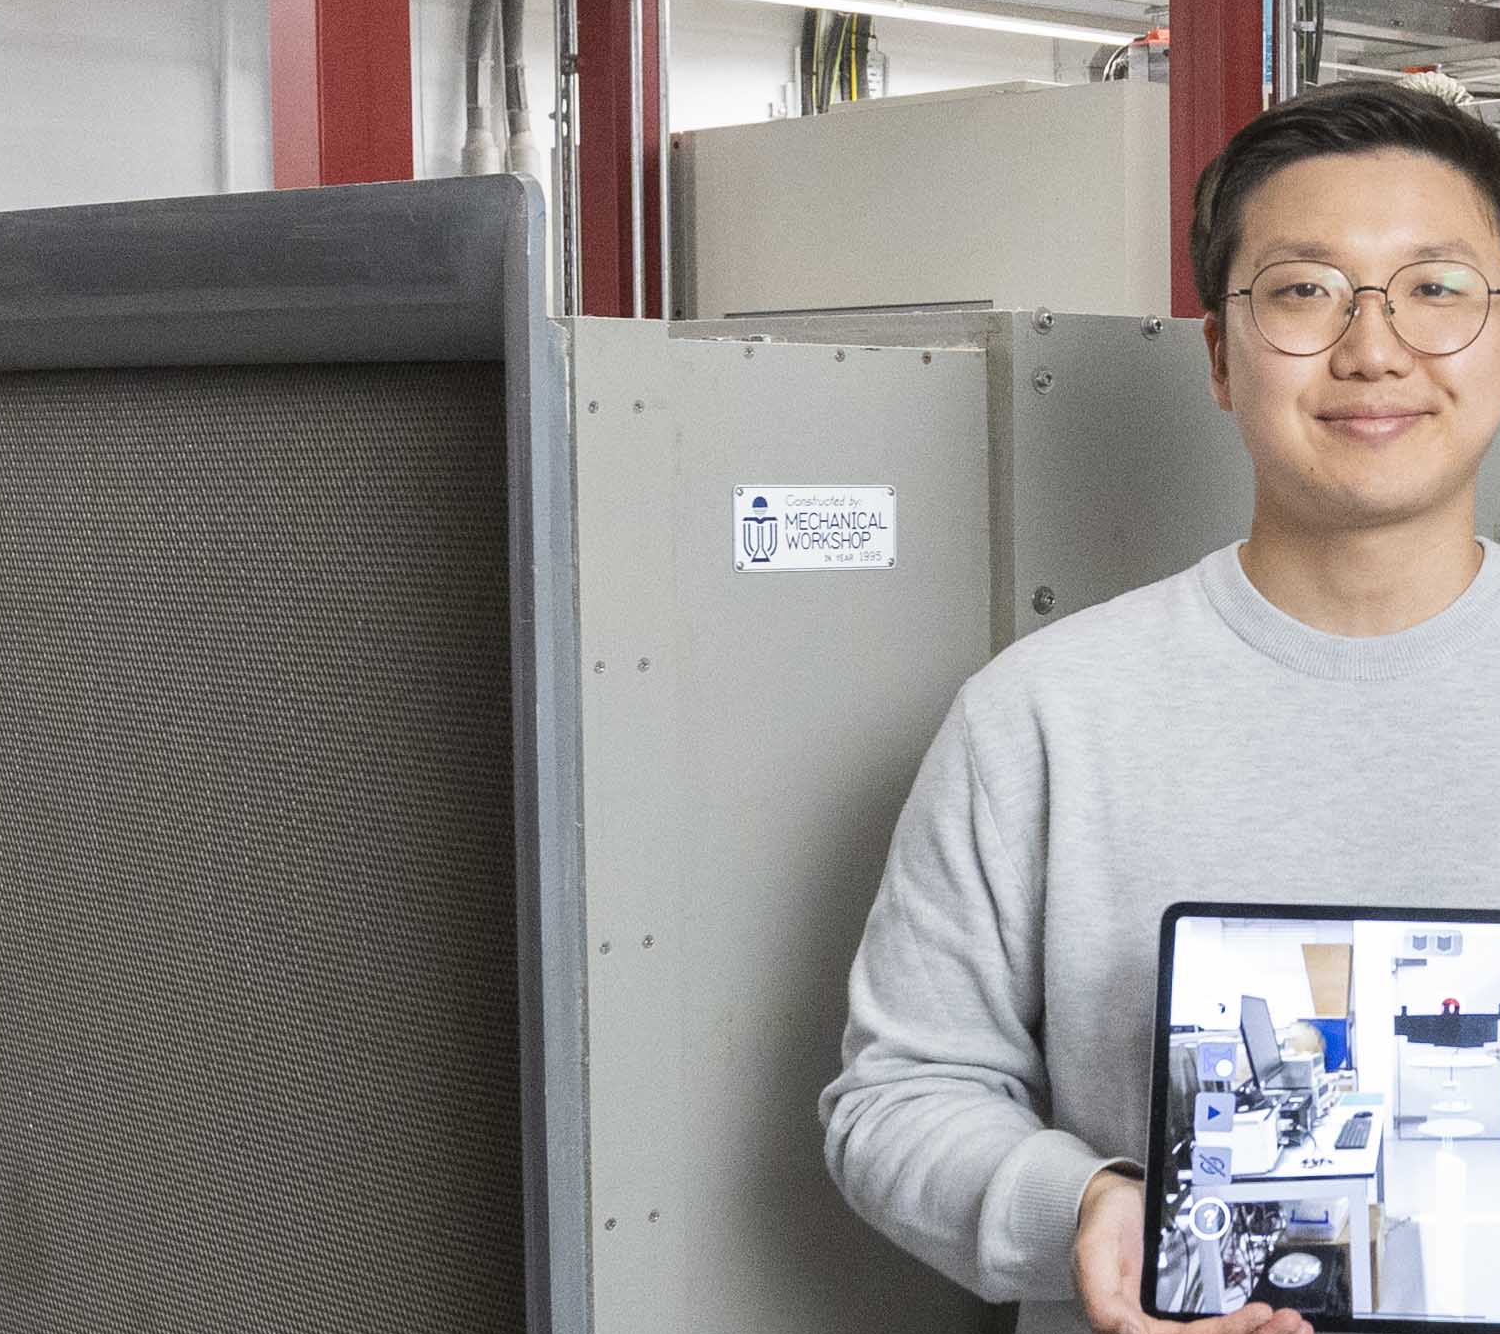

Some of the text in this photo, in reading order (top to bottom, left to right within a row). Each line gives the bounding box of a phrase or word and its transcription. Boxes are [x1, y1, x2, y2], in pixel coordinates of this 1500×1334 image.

[785, 494, 845, 507] Constructed
[785, 512, 889, 530] MECHANICAL
[786, 532, 872, 550] WORKSHOP
[859, 551, 884, 562] 1995
